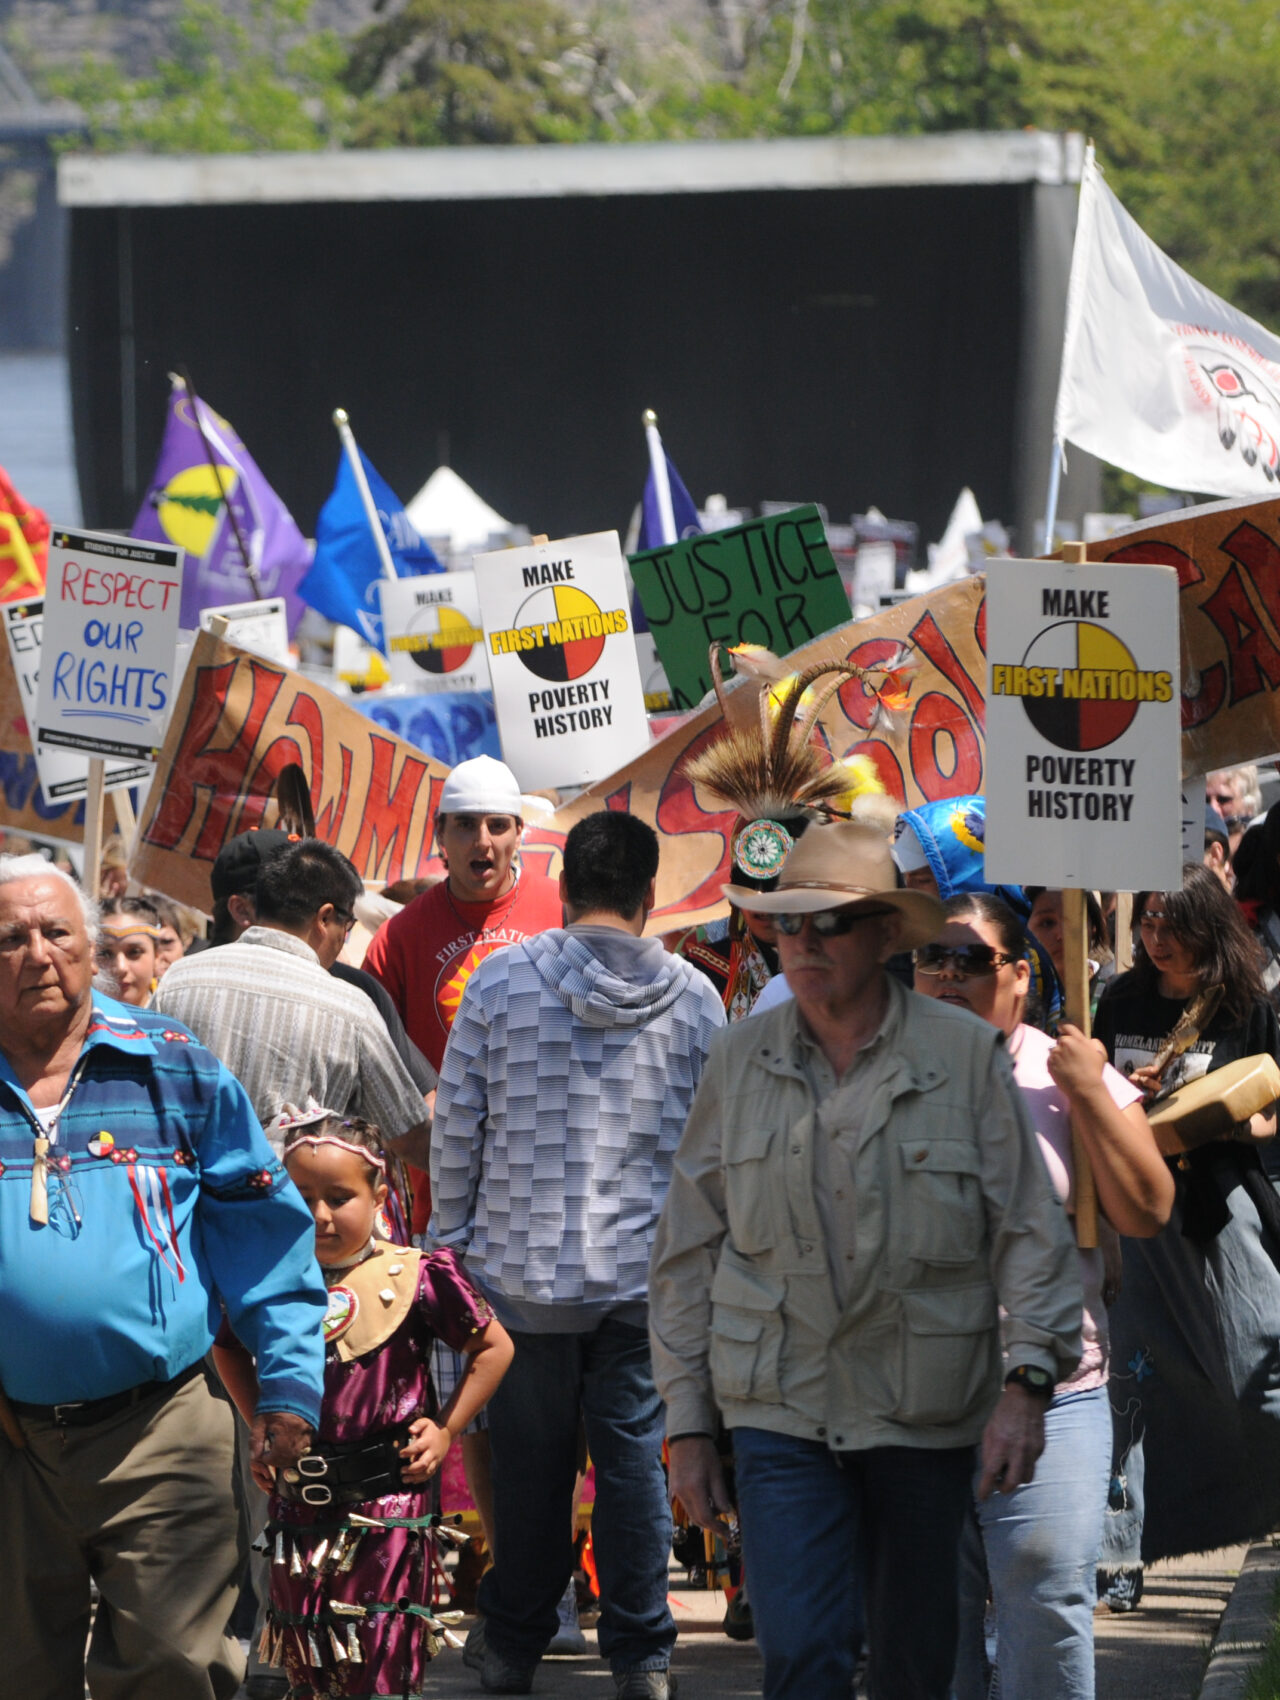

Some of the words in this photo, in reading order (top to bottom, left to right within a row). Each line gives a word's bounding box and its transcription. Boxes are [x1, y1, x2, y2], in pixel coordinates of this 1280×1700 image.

[61, 561, 179, 612] RESPECT
[522, 559, 575, 587] MAKE
[629, 515, 838, 626] JUSTICE
[1041, 588, 1110, 618] MAKE
[83, 619, 144, 654] OUR
[489, 623, 544, 655] FIRST
[546, 608, 629, 646] NATIONS
[702, 593, 816, 651] FOR
[53, 651, 167, 711] RIGHTS
[529, 679, 609, 713] POVERTY
[992, 664, 1058, 698] FIRST
[1062, 668, 1173, 702] NATIONS
[534, 705, 613, 738] HISTORY
[1026, 755, 1136, 787] POVERTY
[1027, 789, 1134, 822] HISTORY
[434, 931, 476, 963] FIRST
[483, 927, 533, 942] NATI
